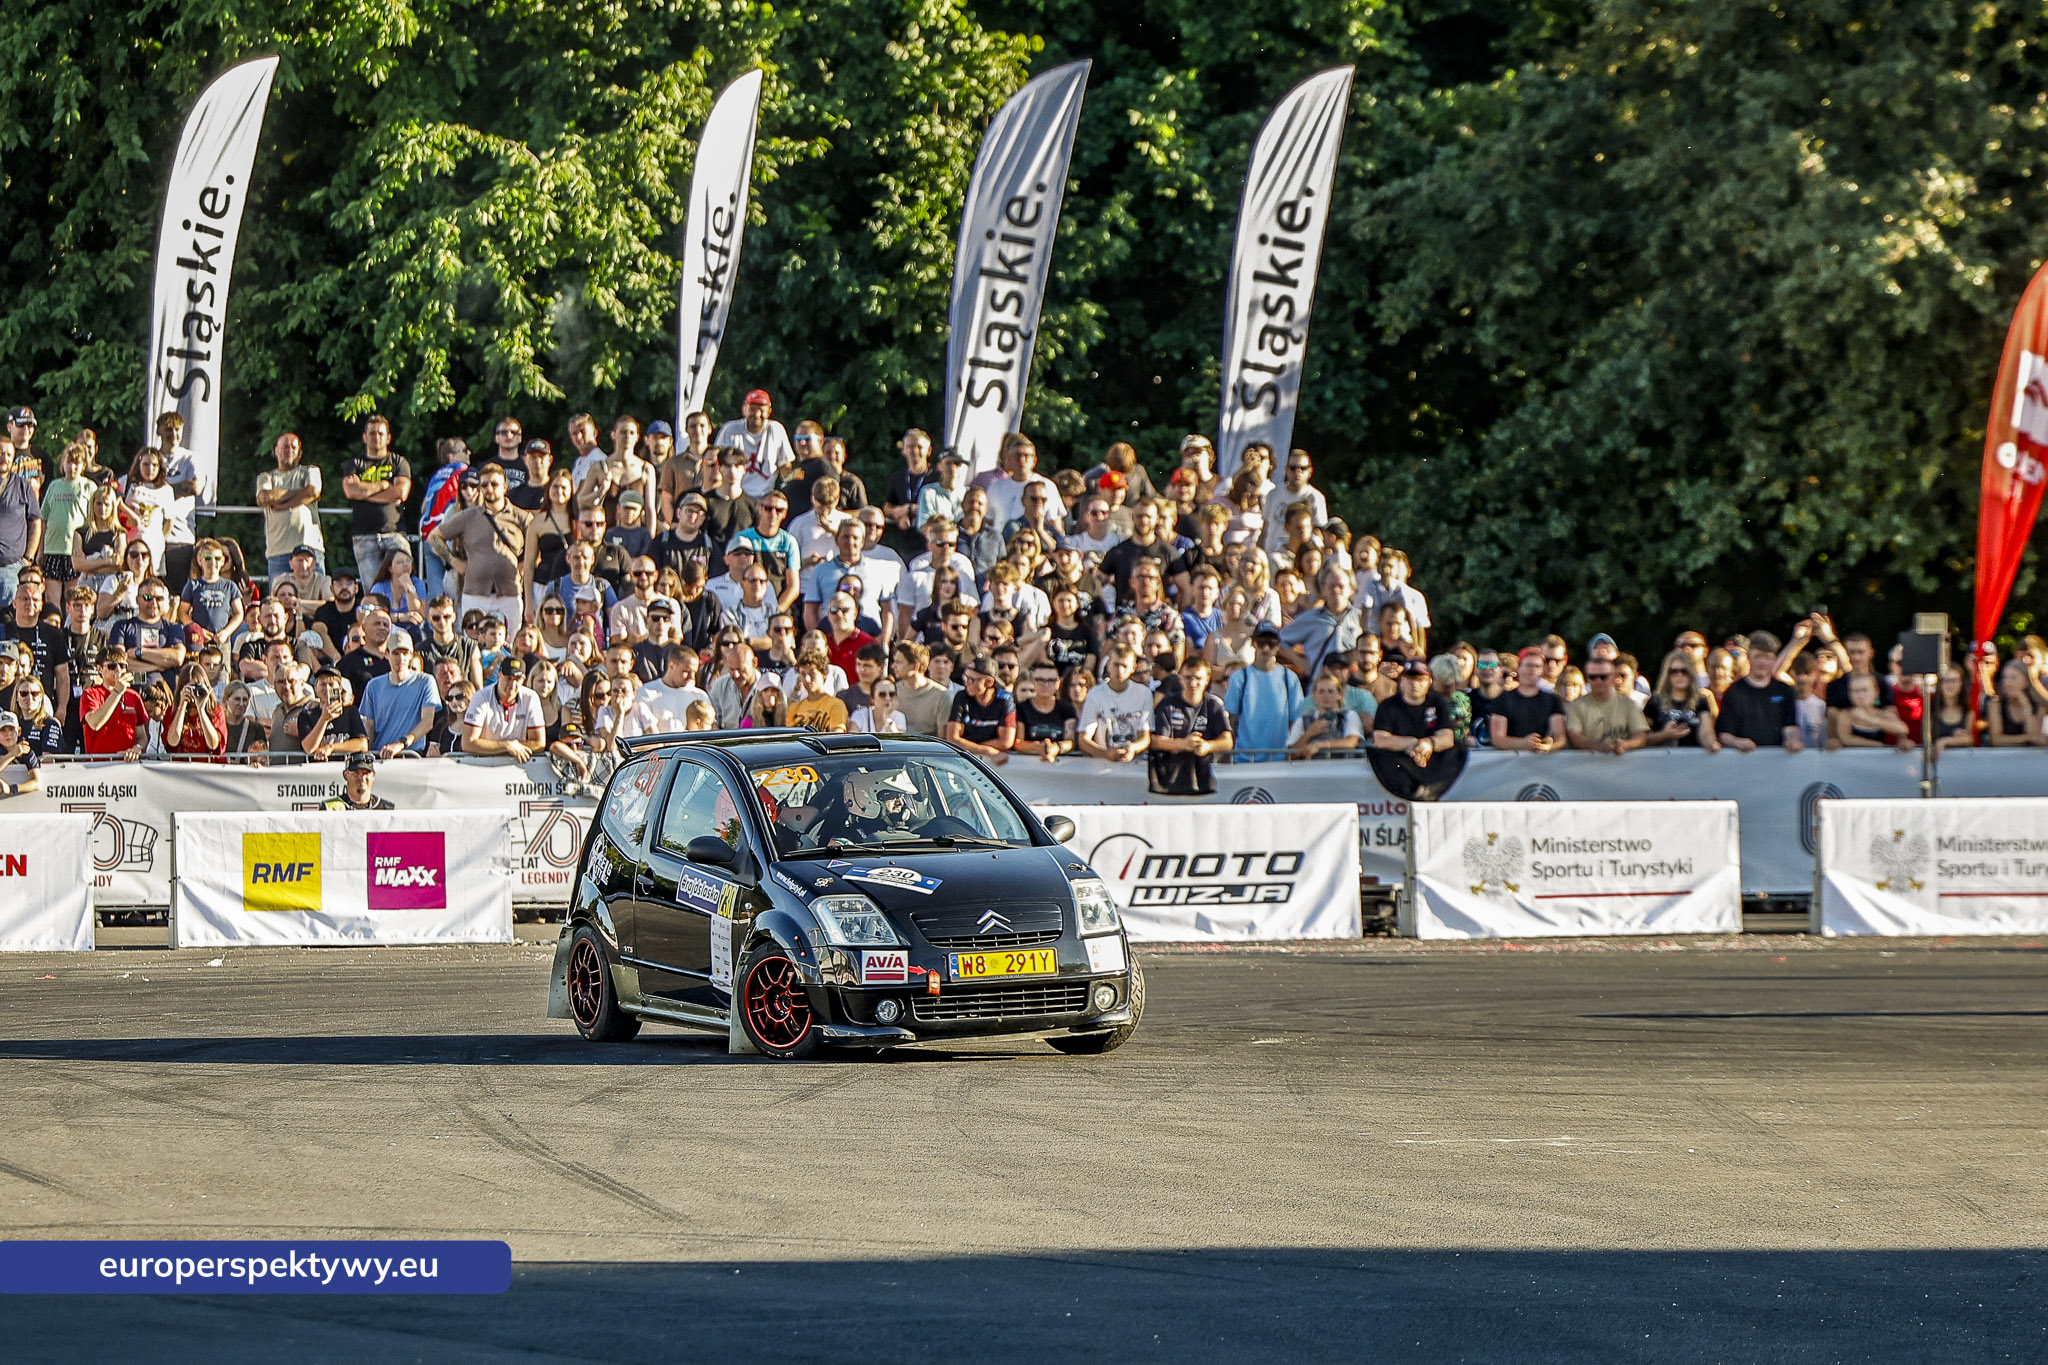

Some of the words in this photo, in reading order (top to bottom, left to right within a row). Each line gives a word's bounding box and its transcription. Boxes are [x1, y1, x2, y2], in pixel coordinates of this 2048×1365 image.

[157, 174, 235, 402] Śląskie.
[958, 182, 1048, 413] Śląskie.
[1231, 186, 1313, 417] Śląskie.
[756, 765, 819, 788] 230
[46, 785, 94, 798] STADION
[97, 782, 137, 801] ŚLĄSKI
[277, 784, 325, 797] STADION
[505, 782, 552, 796] STADION
[1531, 836, 1653, 854] Ministerstwo
[1936, 835, 2048, 853] Ministerstw
[374, 856, 401, 868] RMF
[521, 856, 540, 869] LAT
[1138, 851, 1306, 878] MOTO
[1531, 860, 1593, 880] Sportu
[1608, 857, 1693, 879] Turystyki
[1937, 859, 1998, 879] Sportu
[252, 862, 314, 884] RMF
[521, 871, 570, 885] LEGENDY
[878, 868, 915, 879] 230
[1130, 883, 1294, 907] WIZJA
[963, 955, 986, 975] W8
[1005, 952, 1050, 973] 291Y
